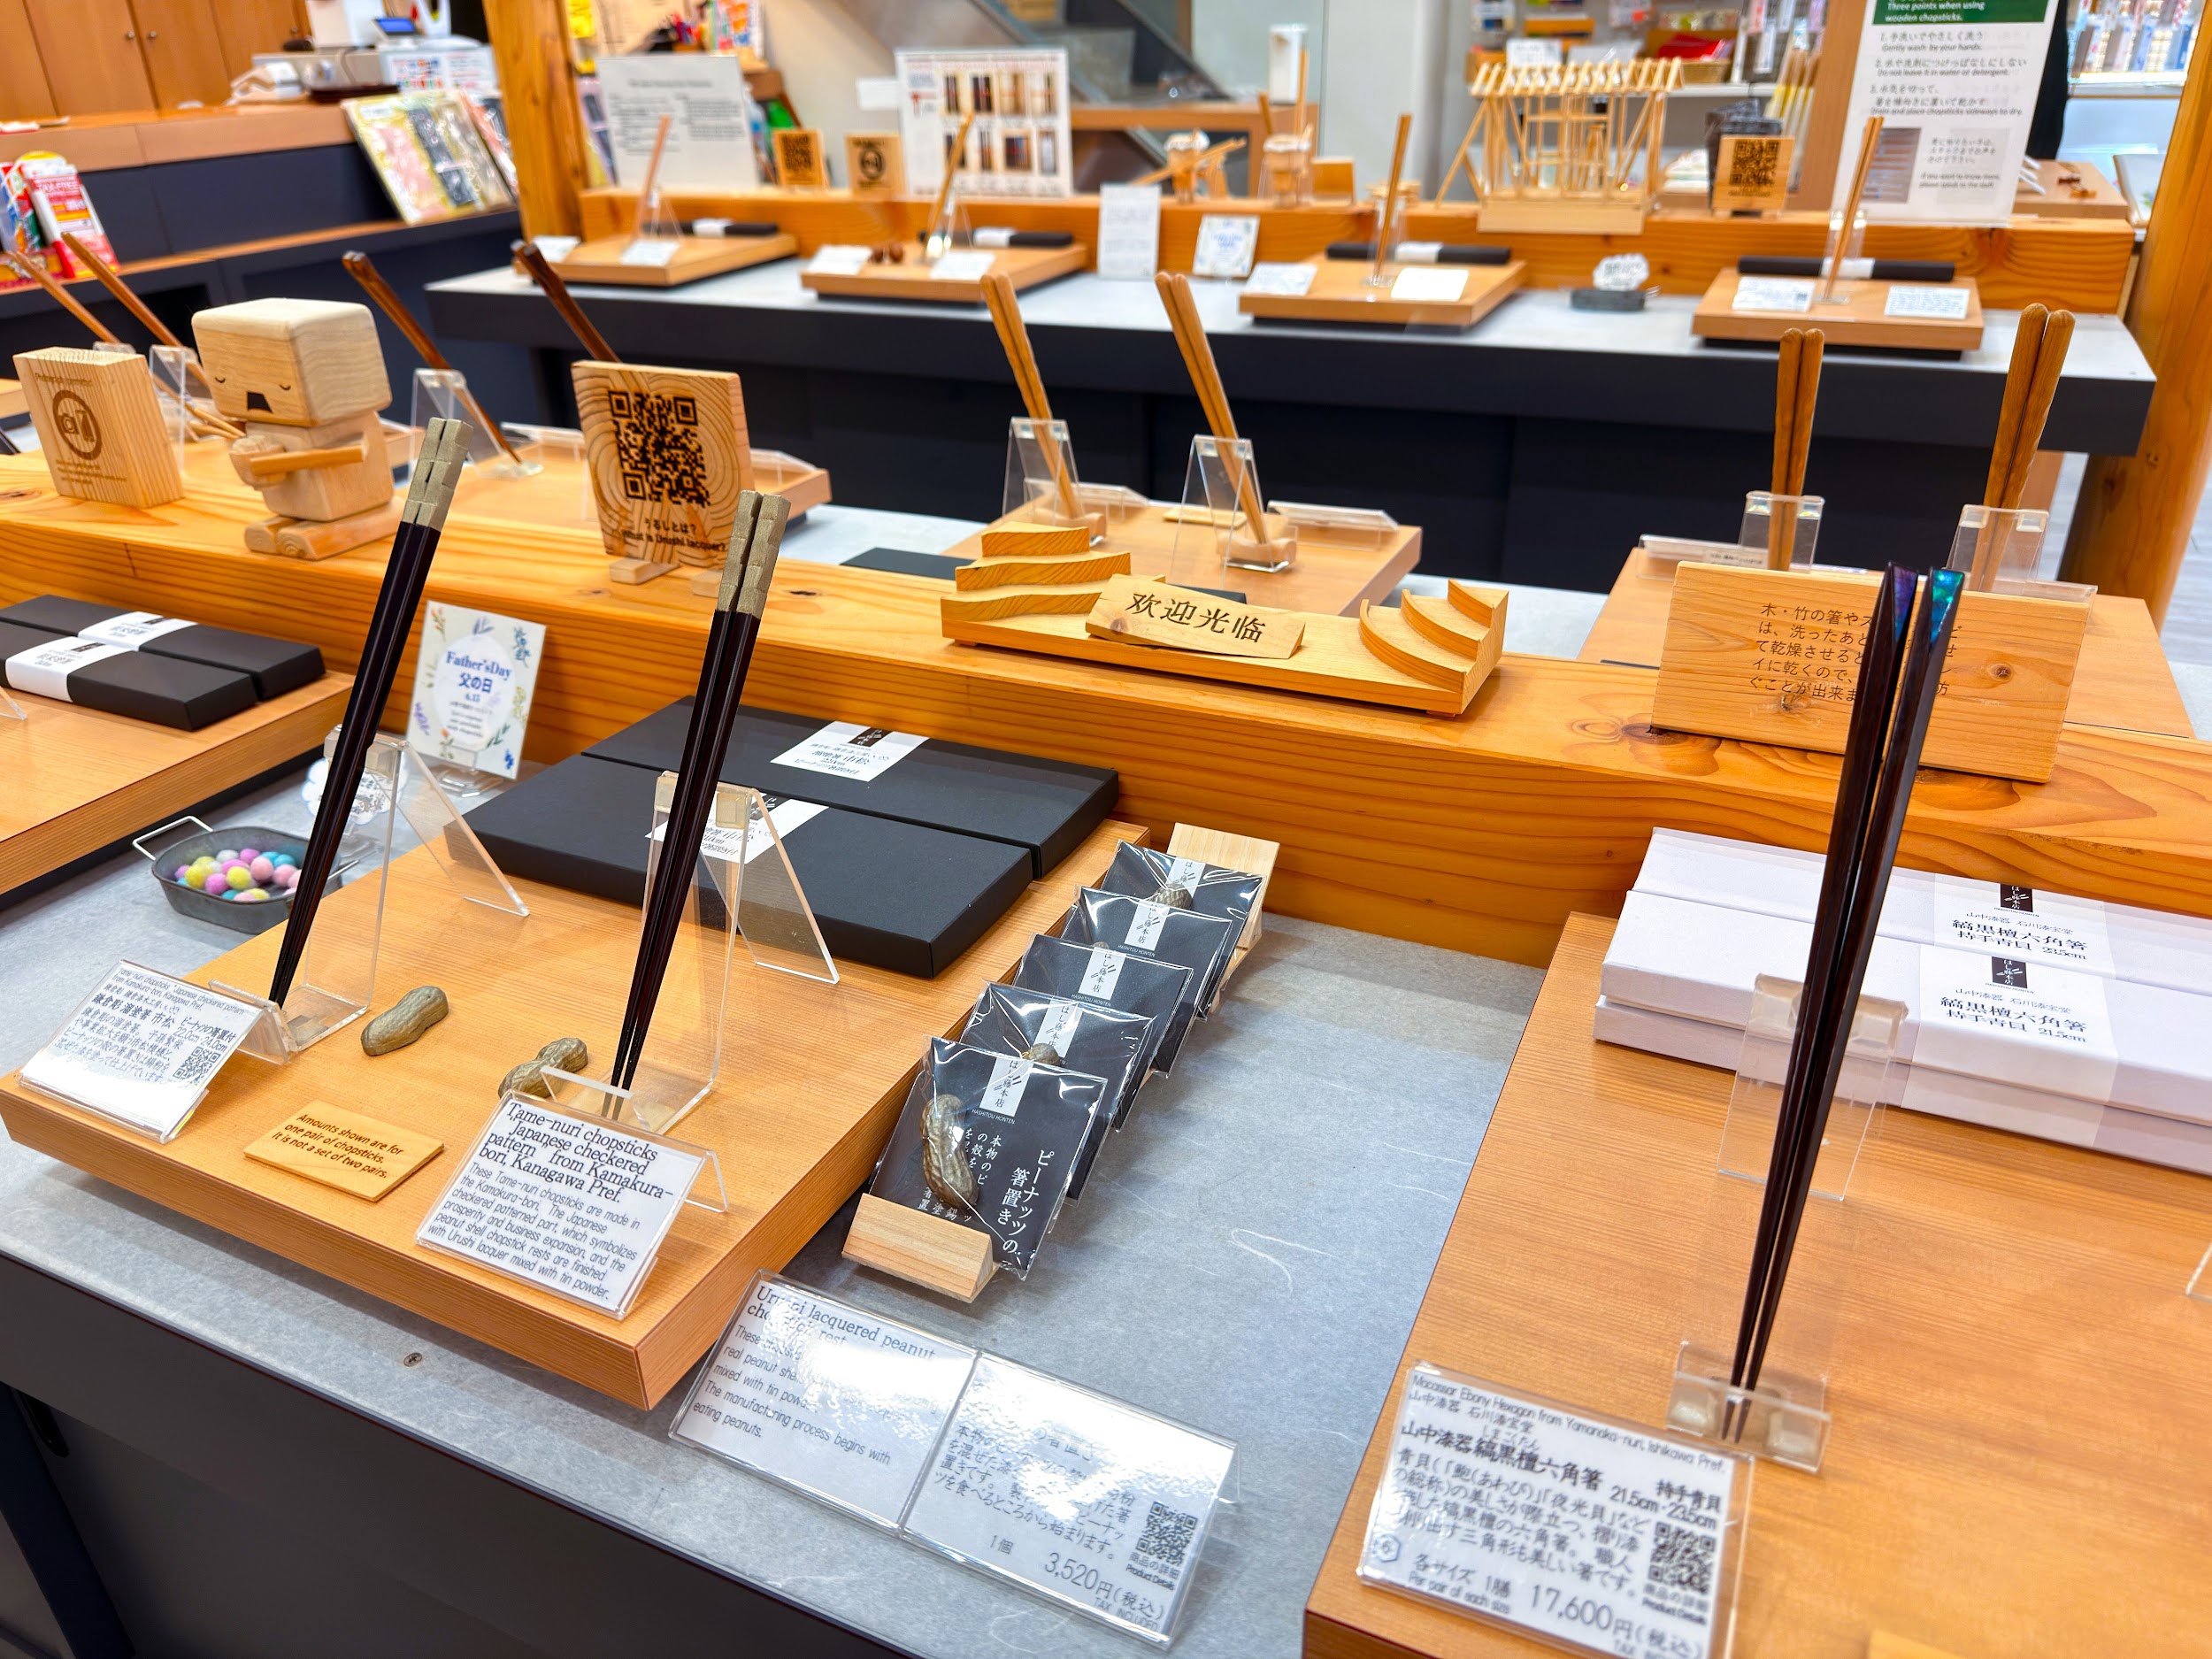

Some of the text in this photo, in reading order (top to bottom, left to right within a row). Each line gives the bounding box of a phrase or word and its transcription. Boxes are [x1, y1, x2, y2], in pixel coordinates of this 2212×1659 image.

[1885, 13, 1917, 22] wooden
[1911, 2, 1937, 11] points
[1962, 1, 1985, 10] using
[1125, 592, 1266, 643] 欢迎光临
[458, 672, 494, 694] 父の日
[91, 993, 124, 1010] 鎌倉彫
[150, 1011, 175, 1029] 市松
[1071, 993, 1112, 1008] HASHITOU HONTEN
[296, 1113, 404, 1156] Amounts shown are for
[506, 1102, 658, 1162] Tame-nuri chopsticks
[972, 1108, 1016, 1125] HASHITOU HONTEN
[280, 1133, 290, 1144] is
[288, 1138, 310, 1150] not
[313, 1146, 331, 1158] set
[330, 1152, 345, 1163] of
[342, 1156, 363, 1169] two
[359, 1163, 388, 1179] pairs.
[284, 1123, 385, 1164] one pair of chopsticks.
[573, 1141, 650, 1176] checkered
[478, 1143, 626, 1204] bori, Kanagawa Pref.
[548, 1148, 588, 1173] from
[586, 1160, 673, 1199] Kamakura-
[459, 1174, 476, 1187] the
[548, 1203, 566, 1220] The
[565, 1211, 609, 1235] Japanese
[468, 1161, 641, 1231] These Tame-nuri chopsticks are made in
[433, 1211, 609, 1282] peanut shell chopstick rests are finished
[441, 1199, 488, 1222] prosperity
[486, 1214, 507, 1229] and
[503, 1218, 542, 1242] business
[588, 1252, 611, 1266] and
[609, 1257, 626, 1273] the
[450, 1187, 496, 1210] checkered
[492, 1202, 540, 1225] patterned
[561, 1225, 589, 1244] which
[588, 1236, 639, 1262] symbolizes
[426, 1223, 611, 1301] with Urushi lacquer mixed with tin powder.
[734, 1324, 761, 1346] These
[807, 1303, 937, 1361] lacquered peanut
[712, 1363, 780, 1398] mixed with tin
[722, 1344, 745, 1361] real
[741, 1352, 780, 1374] peanut
[692, 1400, 763, 1439] eating peanuts.
[703, 1379, 723, 1397] The
[791, 1416, 831, 1442] process
[833, 1432, 867, 1455] begins
[867, 1446, 893, 1466] with
[1412, 1374, 1459, 1396] Macassar
[1459, 1386, 1493, 1408] Ebony
[1493, 1394, 1537, 1418] Hexagon
[1537, 1409, 1563, 1426] from
[1647, 1442, 1694, 1464] Ishikawa
[1696, 1453, 1726, 1474] Pref.
[1125, 1563, 1176, 1592] Product Details
